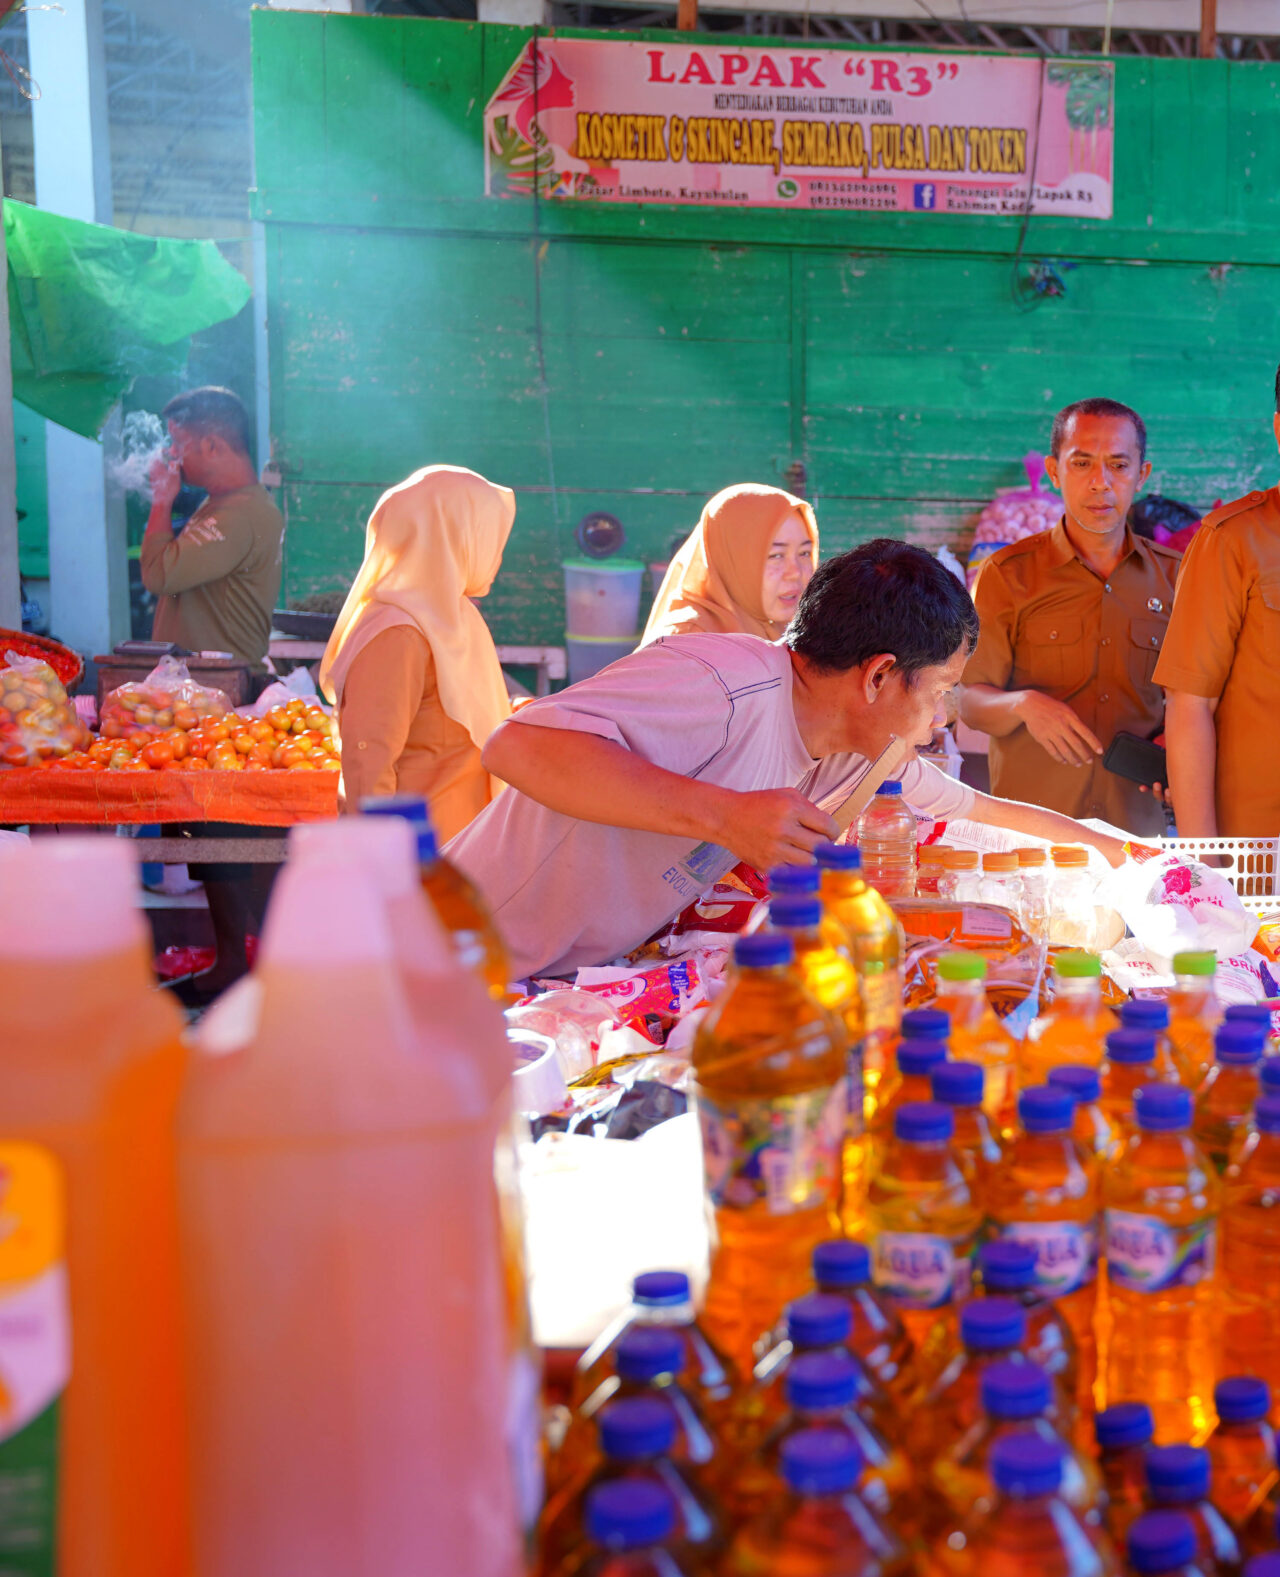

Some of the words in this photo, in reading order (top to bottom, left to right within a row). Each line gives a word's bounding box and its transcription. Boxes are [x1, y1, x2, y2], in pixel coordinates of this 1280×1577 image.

[646, 50, 827, 89] LAPAK
[843, 57, 960, 97] “R3”
[577, 113, 669, 162] KOSMETIK
[685, 118, 780, 175] SKINCARE,
[781, 121, 870, 178] SEMBAKO,
[870, 124, 926, 170] PULSA
[927, 126, 967, 172] DAN
[966, 128, 1028, 174] TOKEN
[946, 199, 997, 211] Rahman
